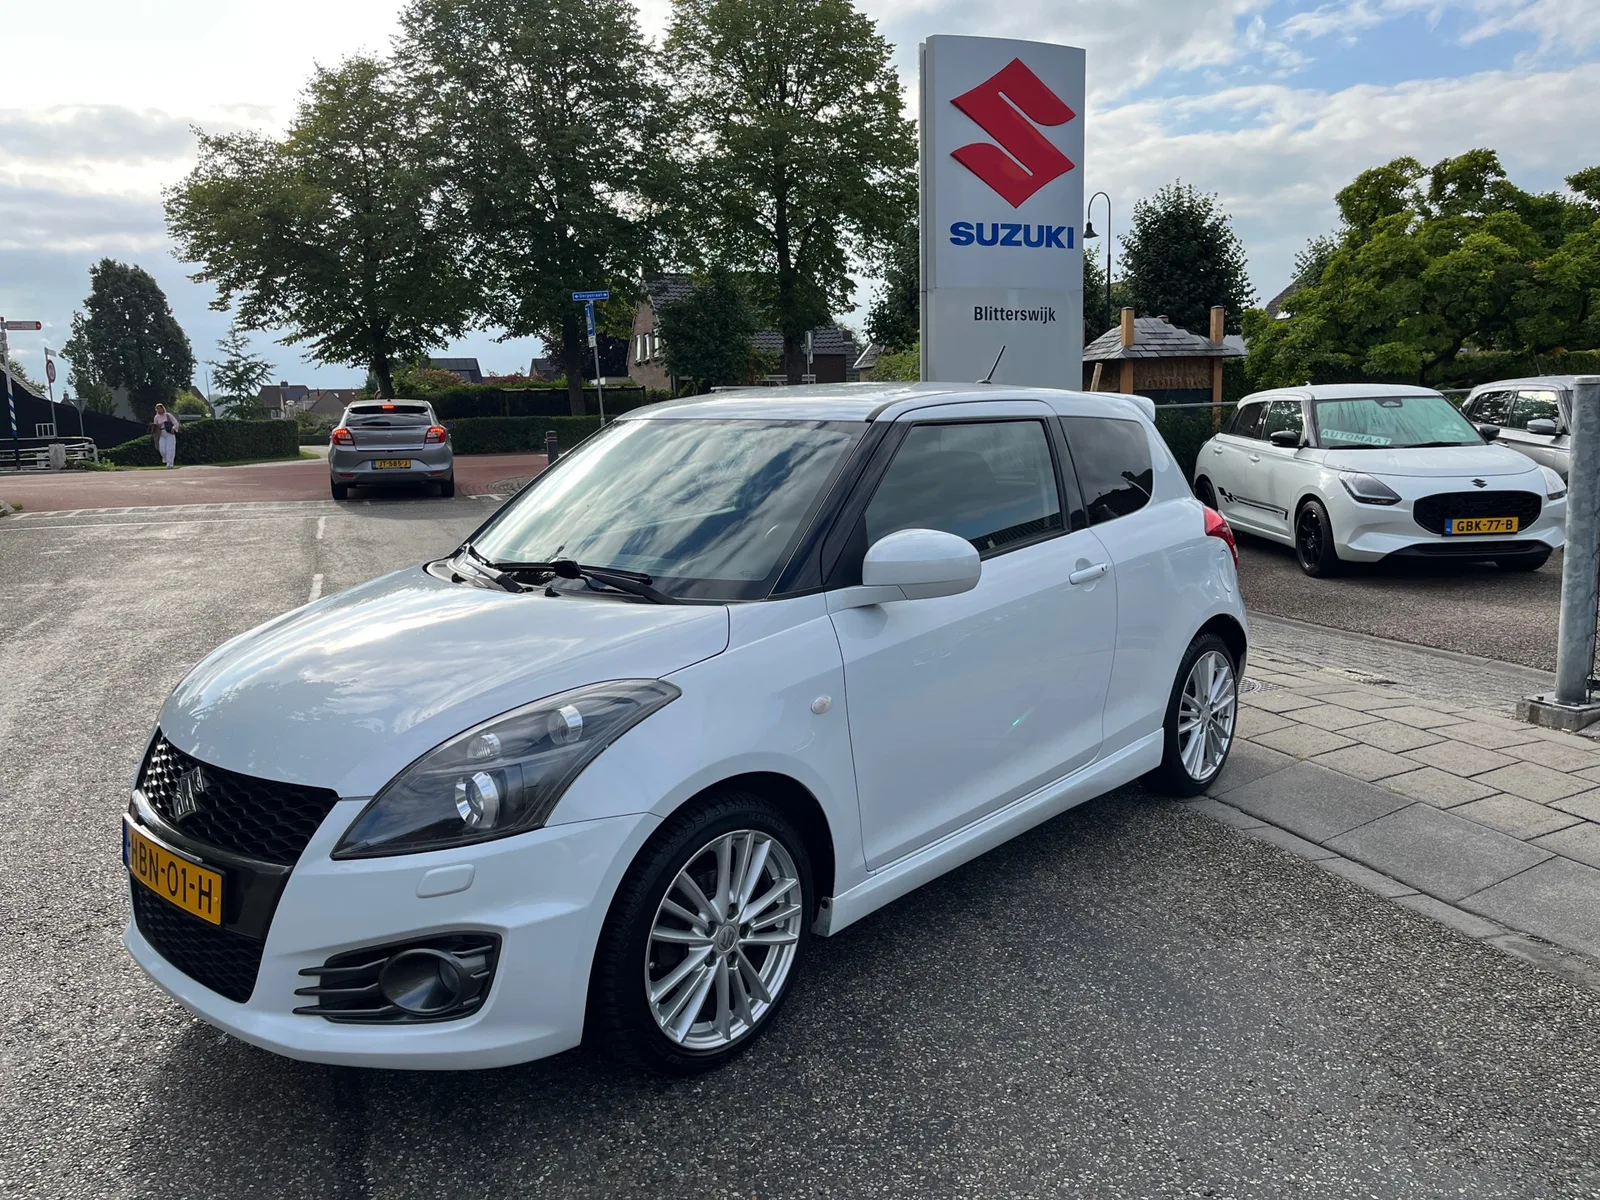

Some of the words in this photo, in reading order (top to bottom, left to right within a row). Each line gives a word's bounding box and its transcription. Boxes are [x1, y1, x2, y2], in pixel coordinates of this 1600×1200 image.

[949, 221, 1074, 249] SUZUKI
[974, 306, 1056, 324] Blitterswijk
[1321, 430, 1391, 446] AUTOMAAT
[1457, 519, 1513, 532] GBK-77-B
[131, 833, 213, 915] HBN-01-H
